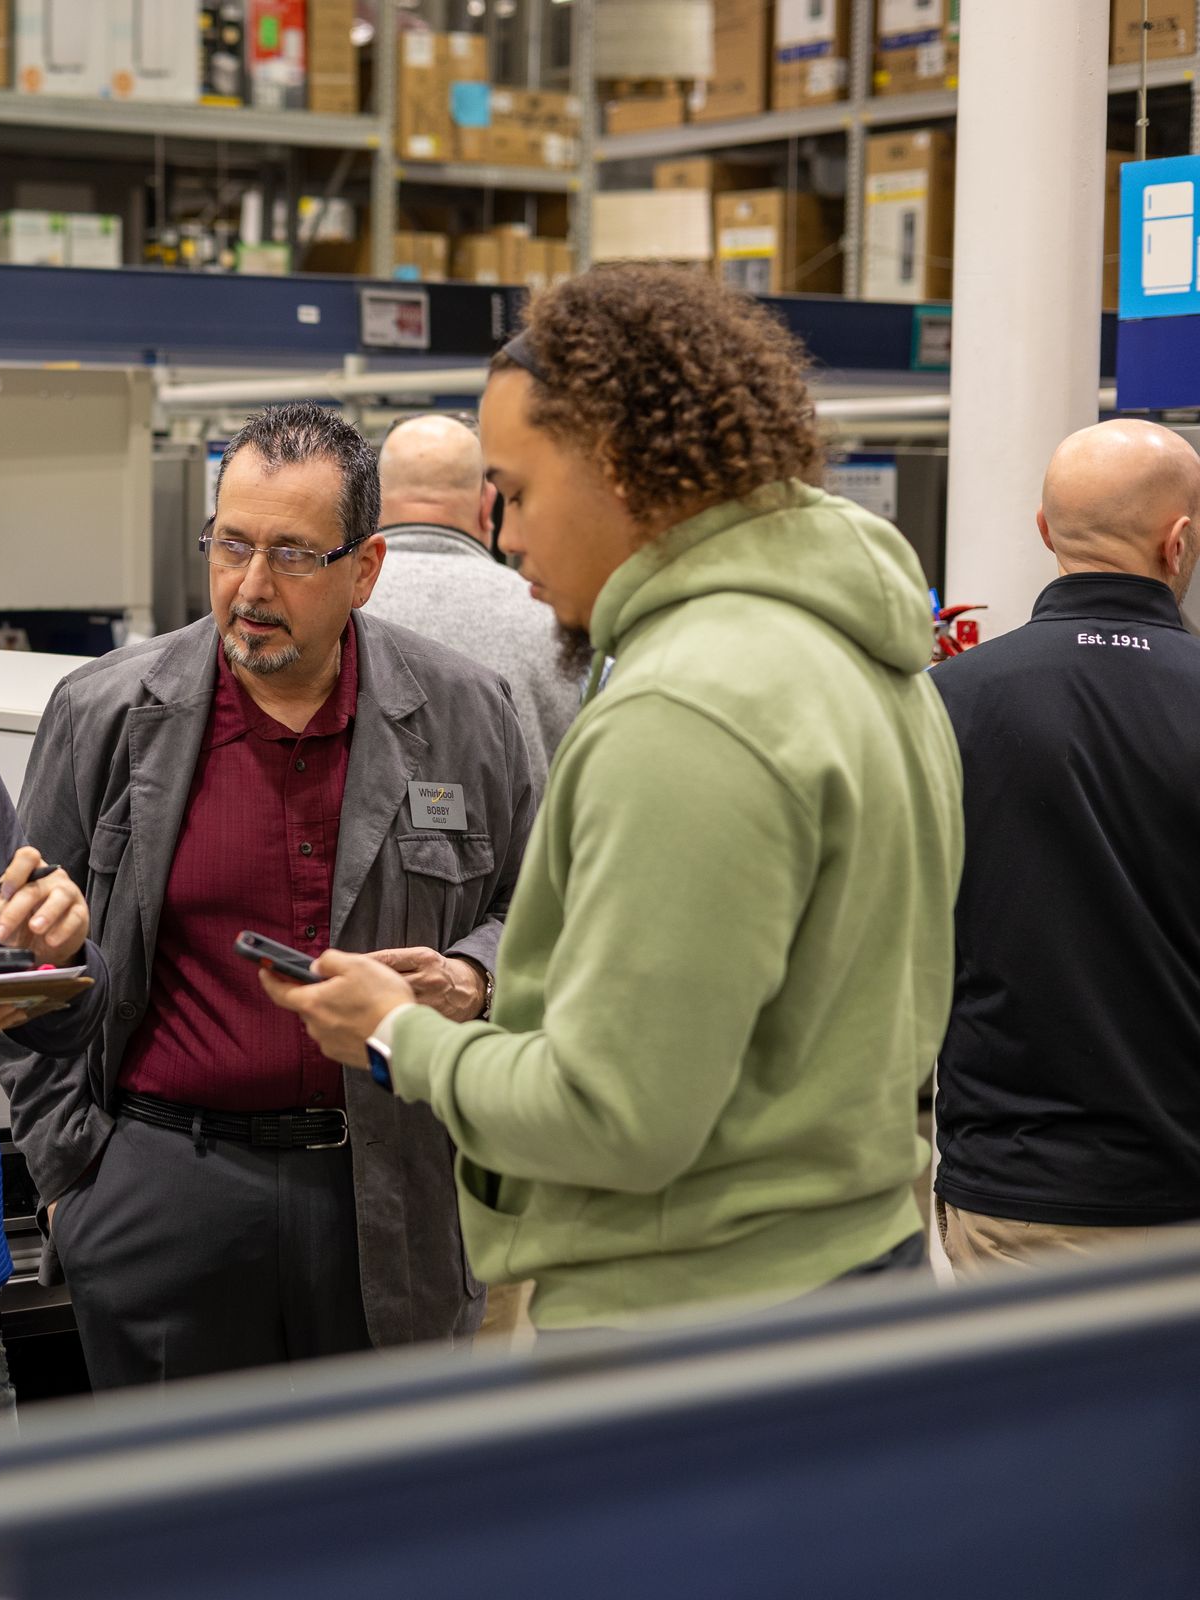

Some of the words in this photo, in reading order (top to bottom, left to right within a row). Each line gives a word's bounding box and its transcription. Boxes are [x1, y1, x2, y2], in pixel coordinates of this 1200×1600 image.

[1077, 633, 1106, 645] Est.
[1111, 634, 1151, 651] 1911
[427, 806, 450, 815] BOBBY
